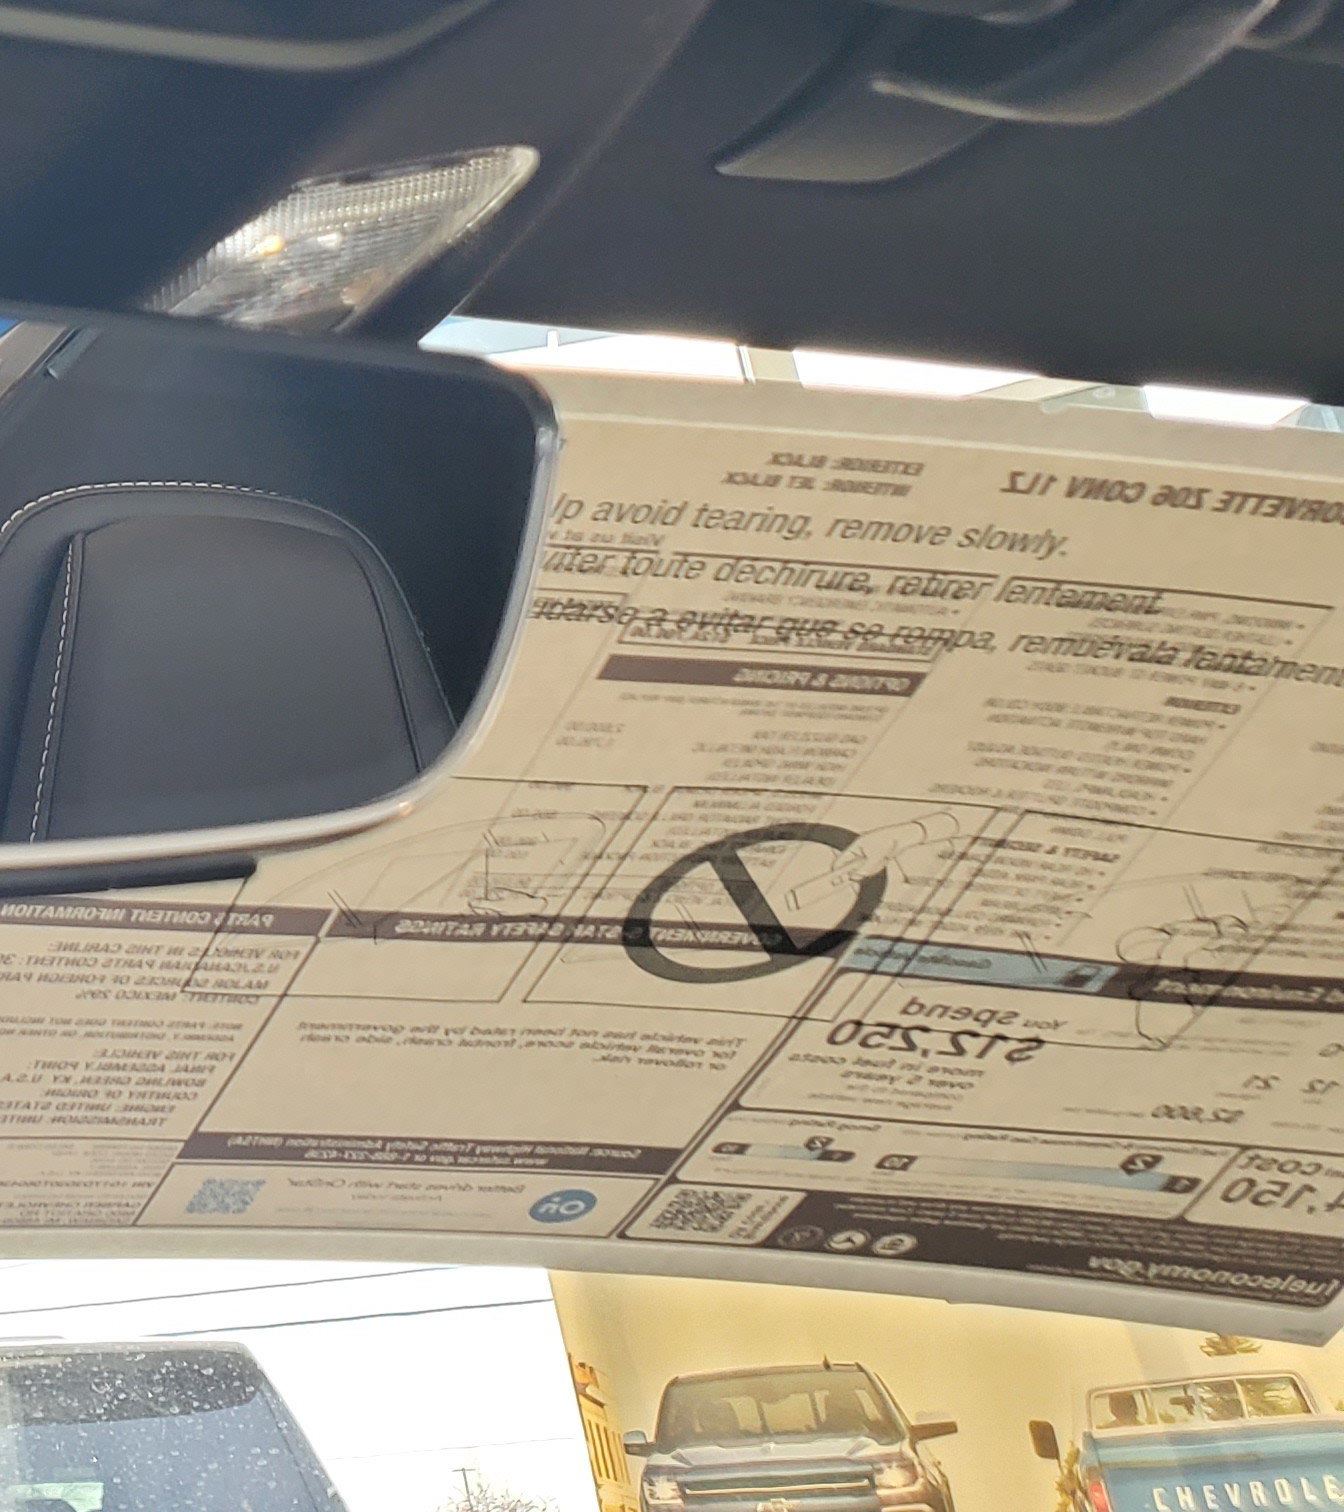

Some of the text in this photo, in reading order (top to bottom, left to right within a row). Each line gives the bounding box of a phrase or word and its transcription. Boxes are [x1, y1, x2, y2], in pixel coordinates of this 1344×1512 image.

[590, 499, 688, 528] avoid
[692, 503, 813, 541] tearing,
[825, 515, 951, 547] remove
[956, 522, 1069, 560] slowly.
[619, 550, 708, 580] toute
[885, 571, 994, 601] retirer
[779, 619, 842, 644] que
